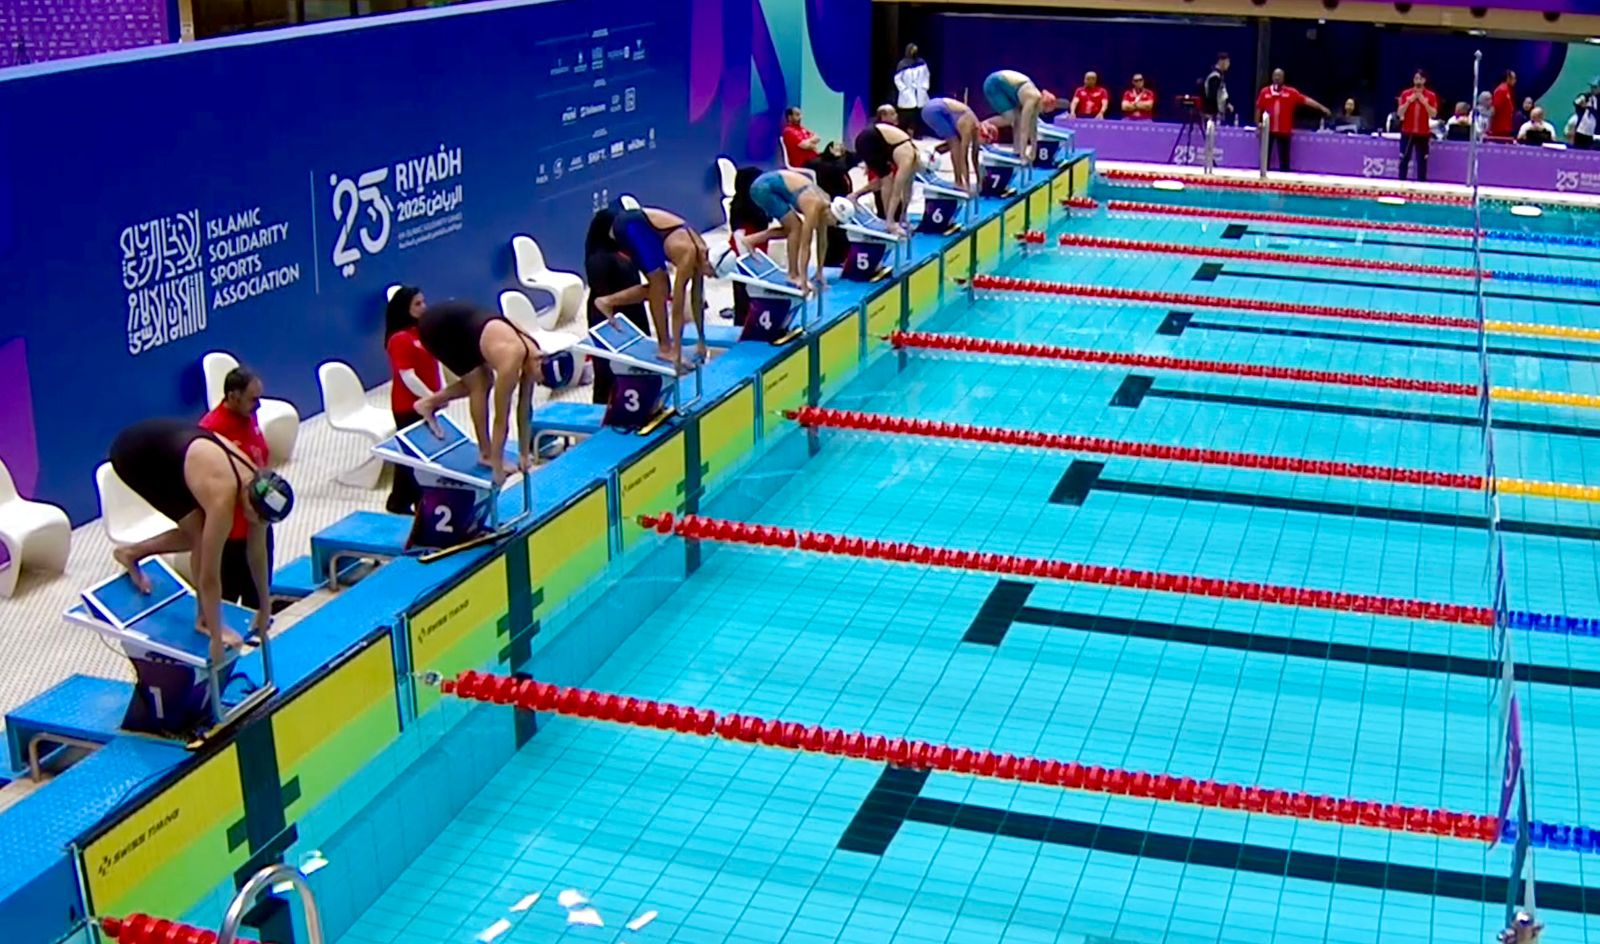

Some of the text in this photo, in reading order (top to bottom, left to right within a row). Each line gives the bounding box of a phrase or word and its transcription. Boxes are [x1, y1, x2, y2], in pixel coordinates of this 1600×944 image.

[395, 144, 462, 193] RIYADH
[1038, 148, 1049, 160] 8
[990, 174, 1001, 189] 7
[397, 184, 463, 222] الرياض 2025
[931, 208, 944, 224] 6
[206, 207, 261, 239] ISLAMIC
[208, 222, 289, 263] SOLIDARITY
[210, 254, 262, 286] SPORTS
[856, 253, 869, 270] 5
[213, 263, 300, 310] ASSOCIATION
[759, 310, 772, 330] 4
[624, 389, 640, 412] 3
[434, 505, 454, 533] 2
[148, 686, 164, 719] 1
[112, 832, 146, 865] SWISS
